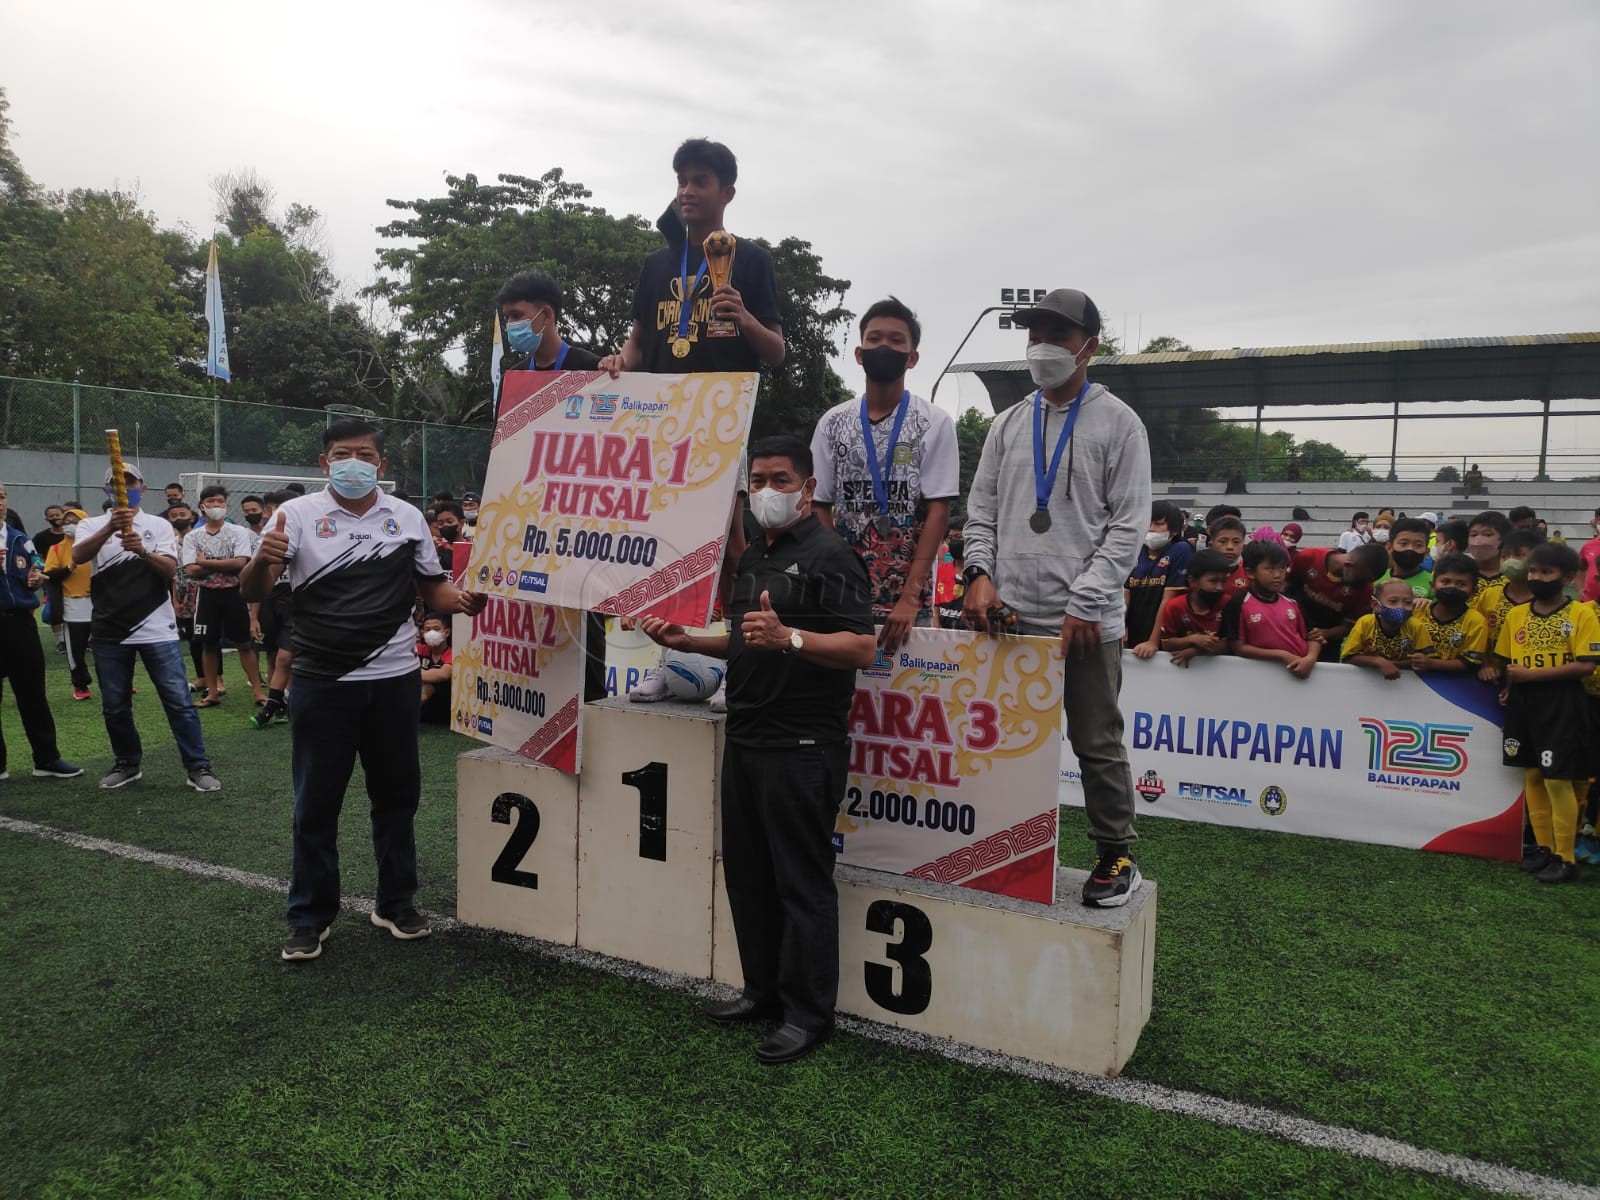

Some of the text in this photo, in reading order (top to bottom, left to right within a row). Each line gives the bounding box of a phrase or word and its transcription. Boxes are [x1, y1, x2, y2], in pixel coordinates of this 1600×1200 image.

[621, 397, 669, 413] Balikpapan
[524, 431, 692, 486] JUARA 1
[541, 481, 651, 523] FUTSAL
[523, 524, 658, 567] Rp. 5.000.000
[470, 597, 556, 648] JUARA 2
[483, 639, 540, 679] FUTSAL
[900, 653, 960, 672] Balikpapan
[477, 676, 545, 718] Rp. 3.000.000
[848, 689, 999, 750] ARA 3
[848, 740, 961, 788] UTSAL
[1133, 711, 1343, 770] BALIKPAPAN
[1359, 717, 1474, 777] 125
[1541, 750, 1553, 767] 8
[1179, 782, 1252, 804] FUTSAL
[1367, 772, 1460, 791] BALIKPAPAN
[622, 762, 668, 861] 1
[847, 787, 976, 836] 2.000.000
[491, 792, 540, 890] 2
[864, 899, 933, 1015] 3
